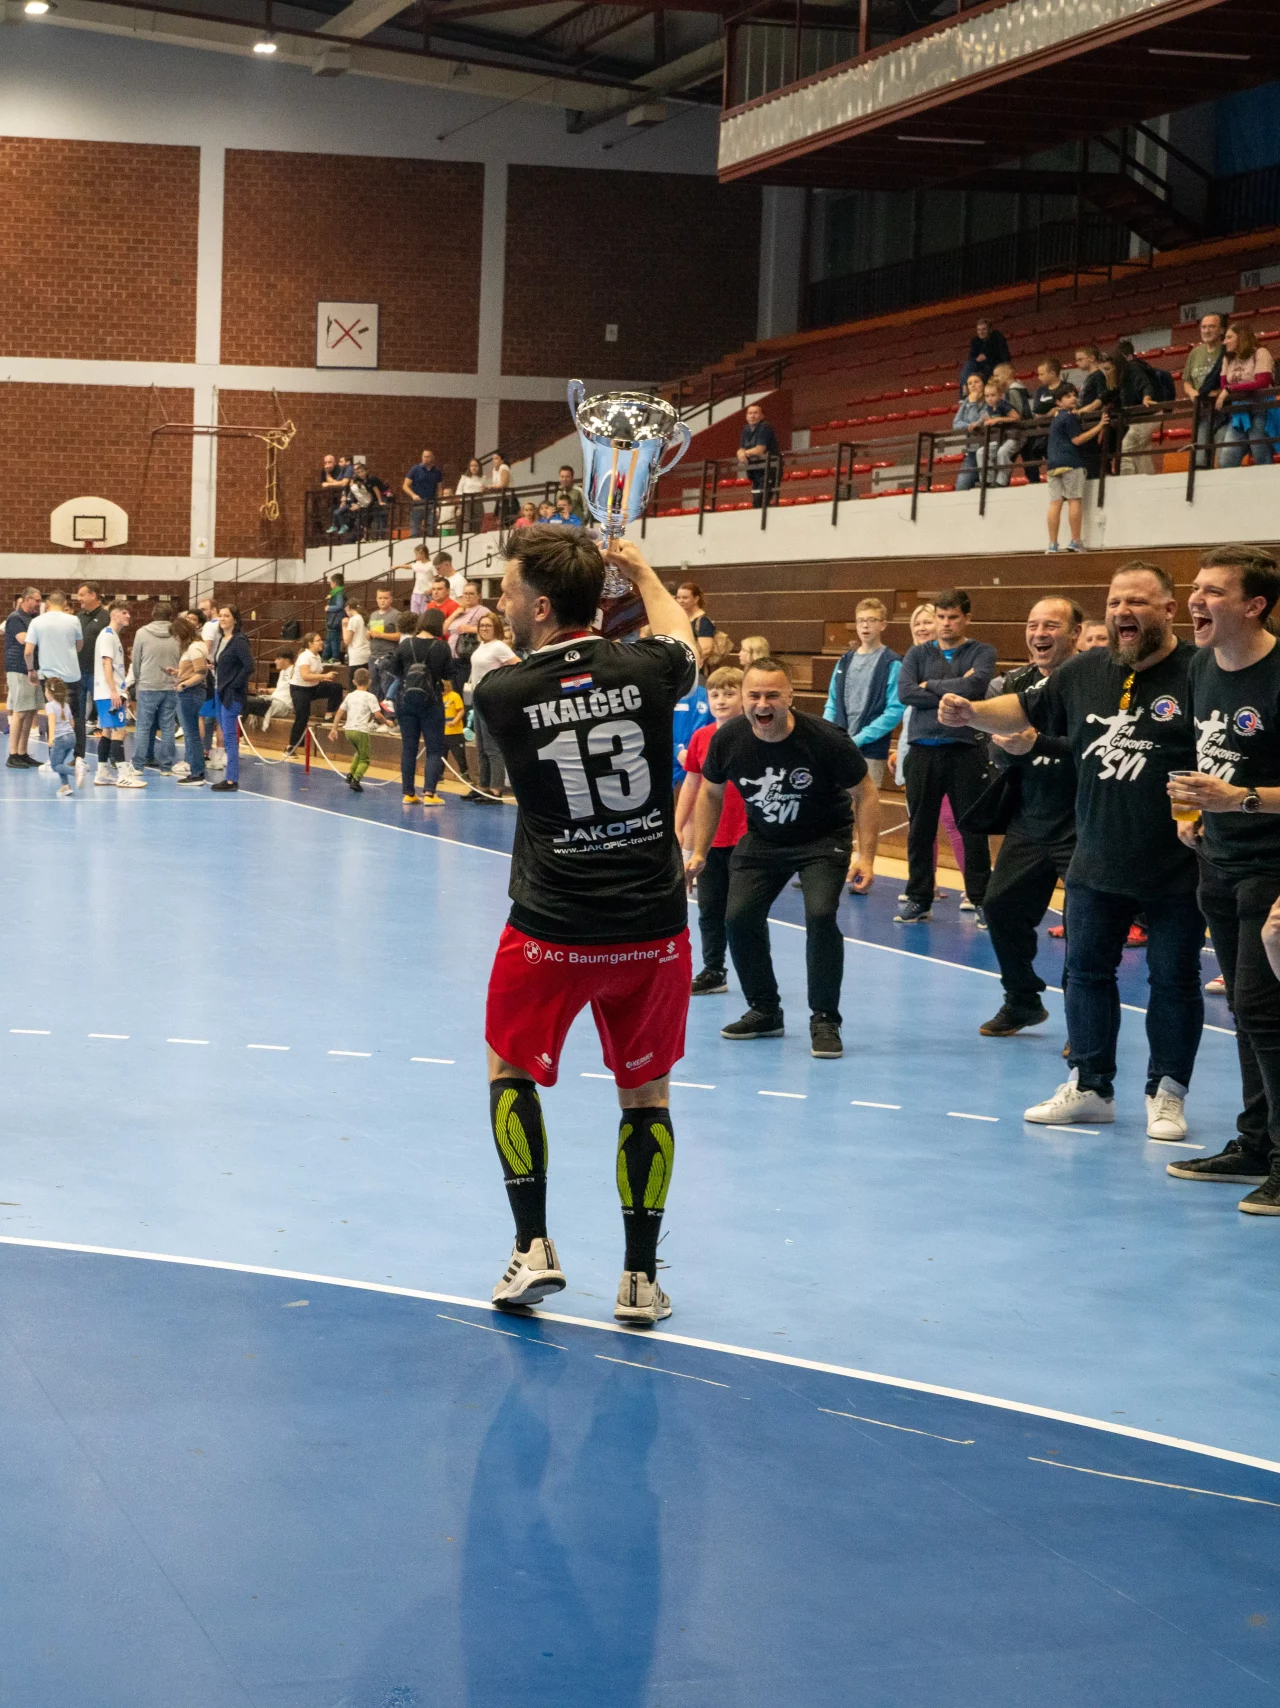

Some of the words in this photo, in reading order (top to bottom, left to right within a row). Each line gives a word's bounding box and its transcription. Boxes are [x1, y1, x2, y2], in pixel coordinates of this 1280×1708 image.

[523, 684, 642, 729] TKALČEC
[1118, 724, 1136, 737] ZA
[1209, 733, 1227, 746] ZA
[1111, 735, 1154, 751] ČAKOVEC
[537, 719, 651, 820] 13
[1097, 749, 1147, 782] SVI
[762, 800, 799, 825] SVI
[553, 808, 663, 844] JAKOPIĆ
[554, 830, 664, 854] www.JAKOPIC-travel.hr
[544, 950, 564, 962] AC
[569, 949, 660, 965] Baumgartner
